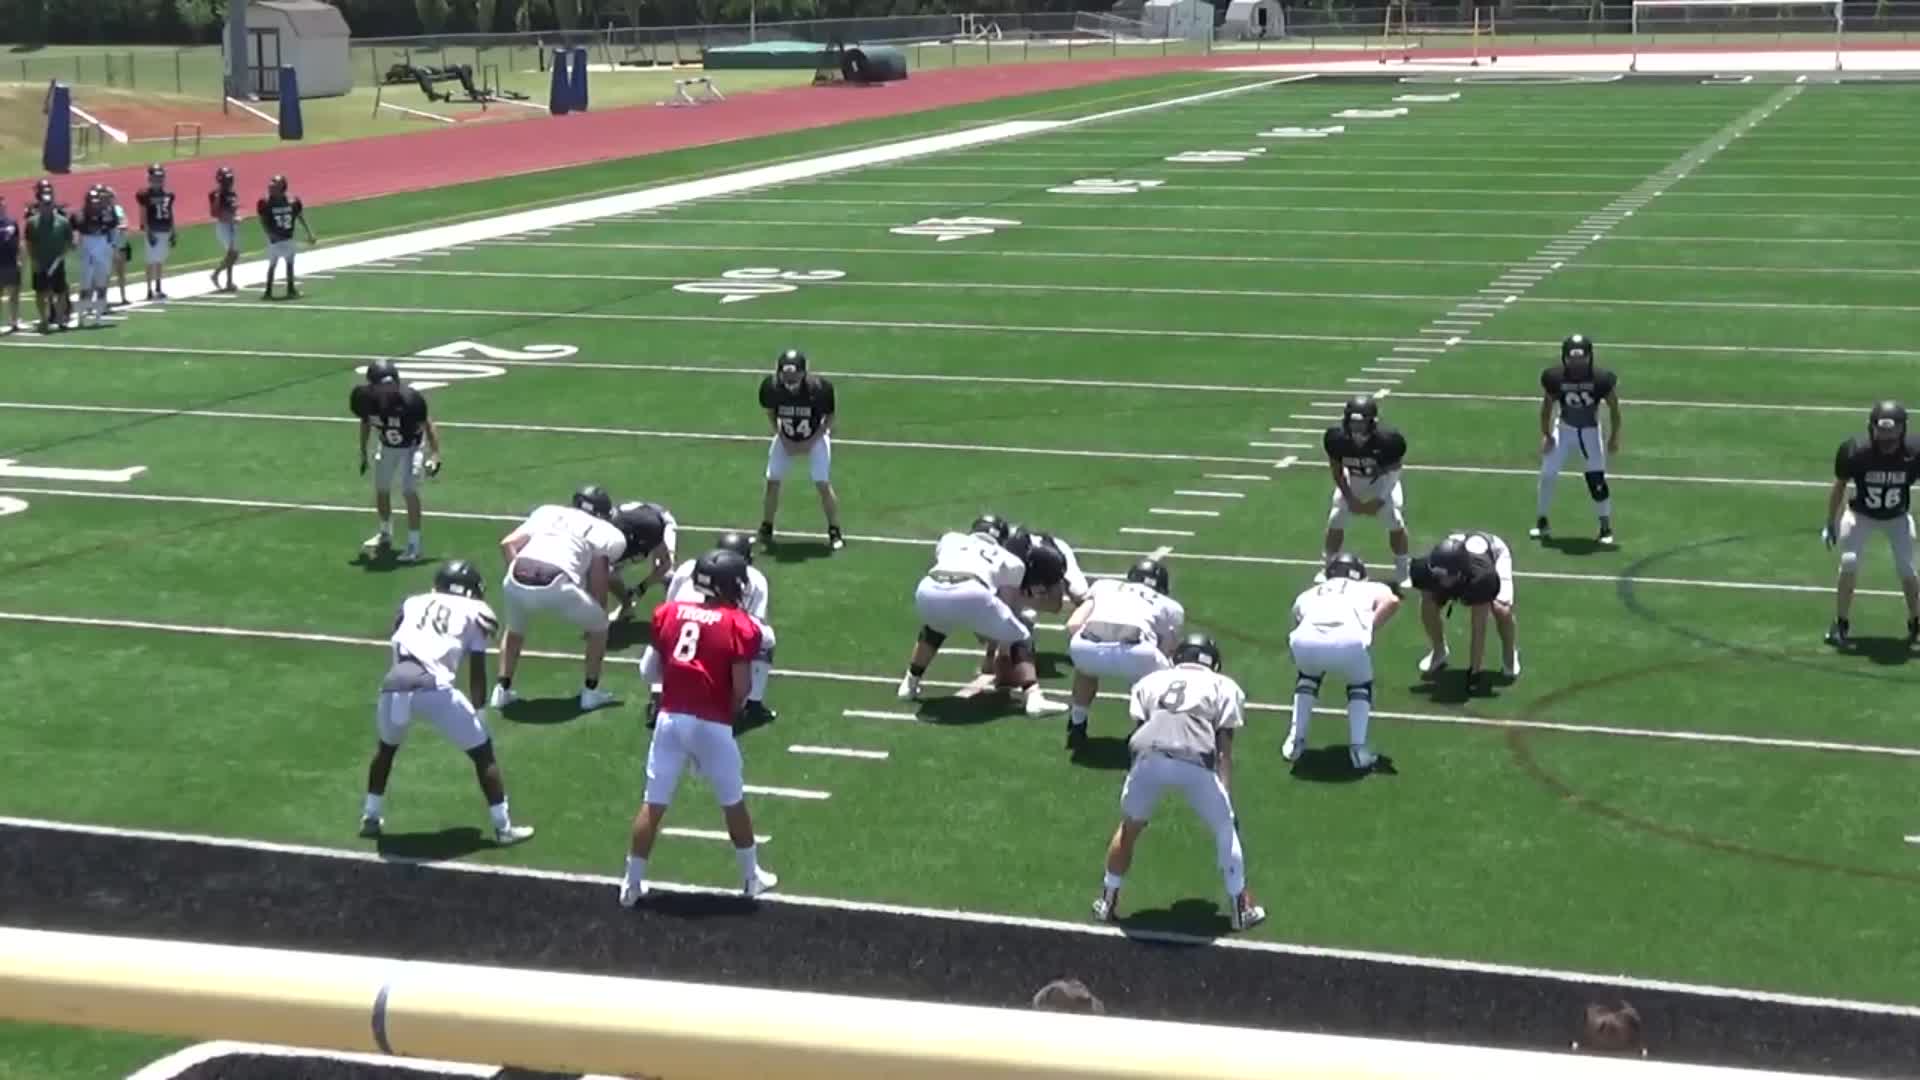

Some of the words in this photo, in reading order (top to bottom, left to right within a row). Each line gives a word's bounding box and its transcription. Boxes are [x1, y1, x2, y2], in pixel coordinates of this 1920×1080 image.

[673, 267, 846, 295] 30
[354, 340, 579, 379] 20
[1864, 487, 1901, 509] 56
[672, 621, 700, 662] 8
[1159, 680, 1188, 714] 8
